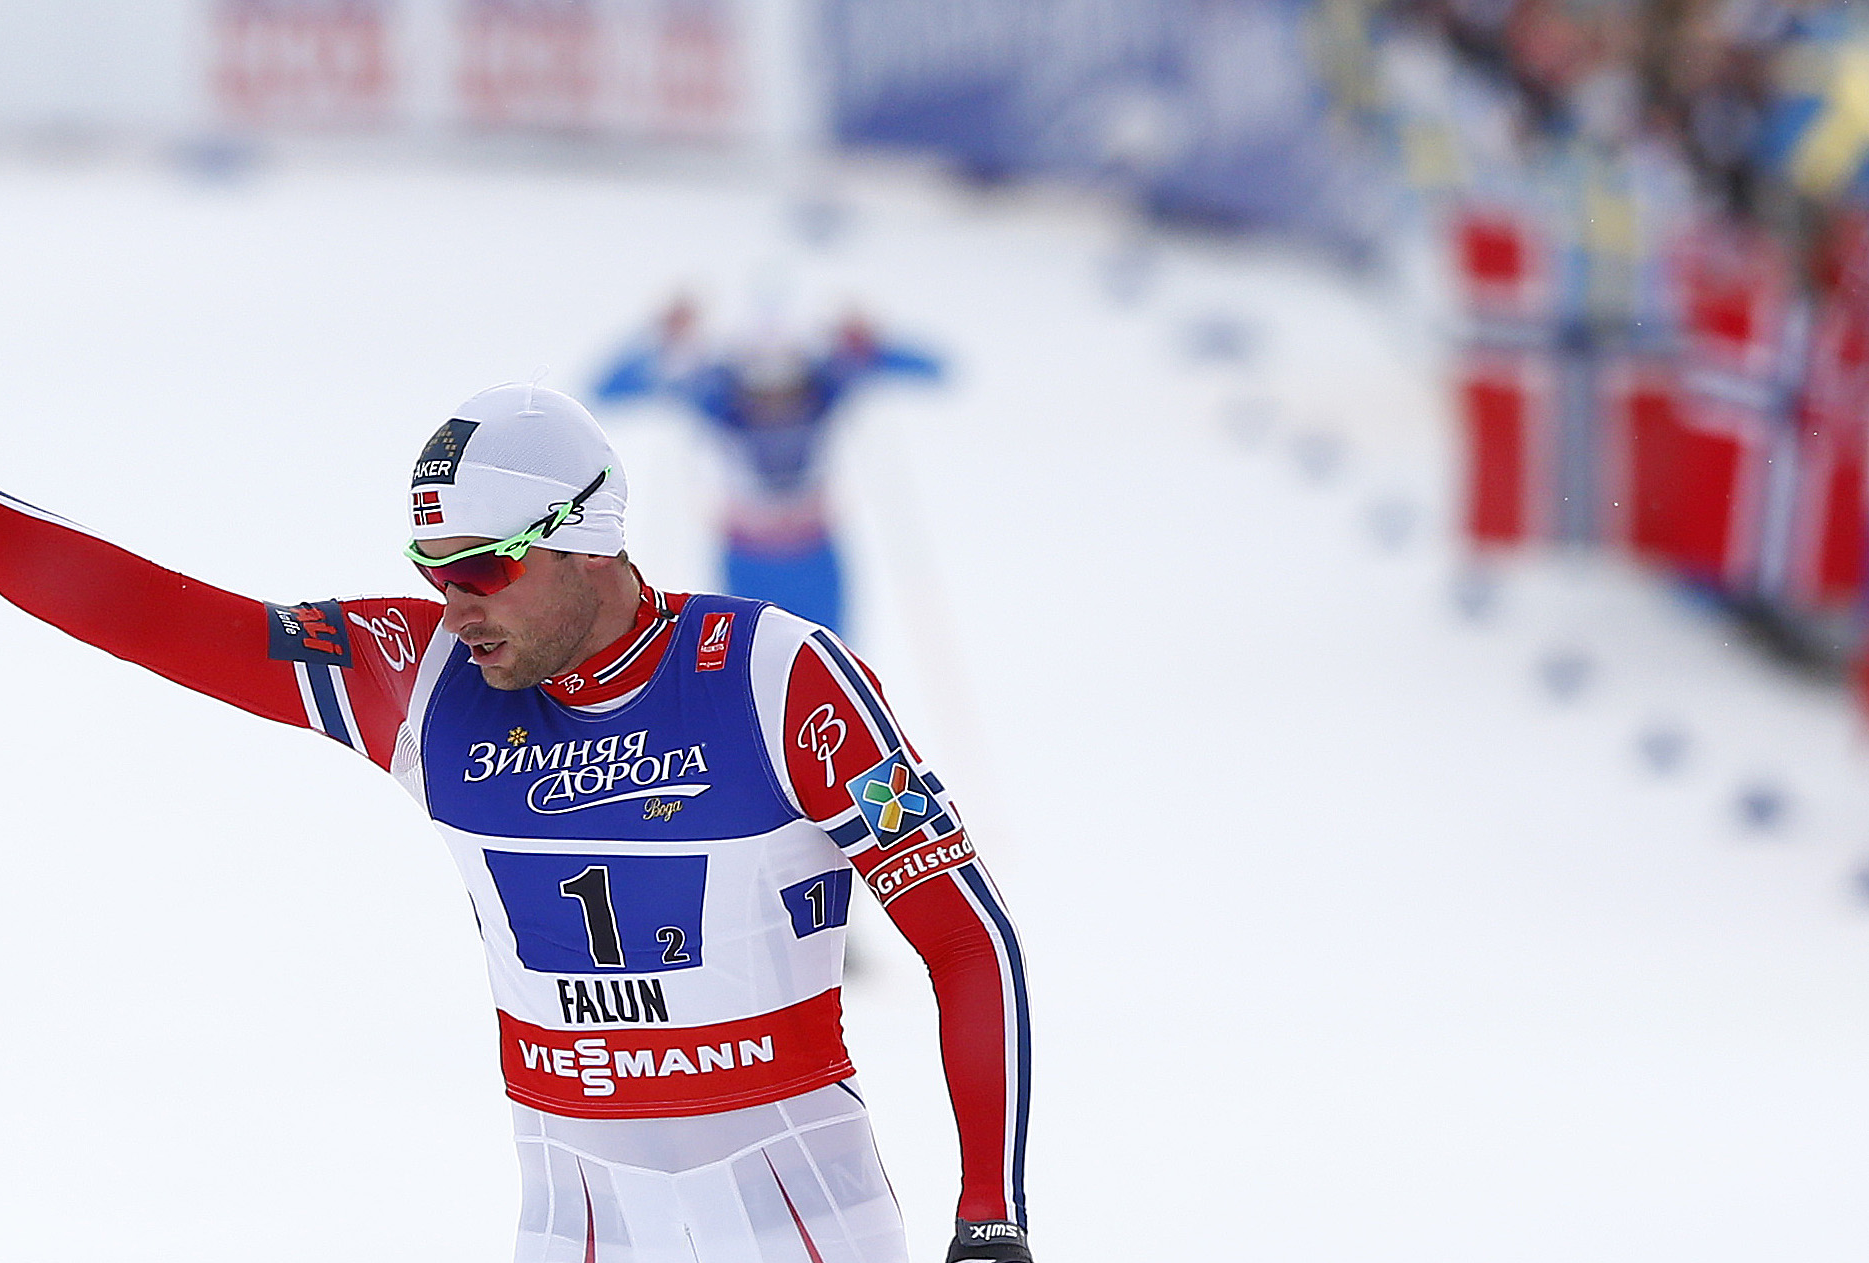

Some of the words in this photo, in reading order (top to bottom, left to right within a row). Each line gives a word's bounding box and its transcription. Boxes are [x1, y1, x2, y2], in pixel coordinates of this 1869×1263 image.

[412, 460, 453, 480] AKER
[876, 831, 973, 895] Grilstad
[559, 865, 626, 968] 1
[656, 926, 691, 964] 2
[803, 880, 826, 928] 1
[555, 977, 671, 1025] FALUN
[518, 1035, 776, 1097] VIESSMANN
